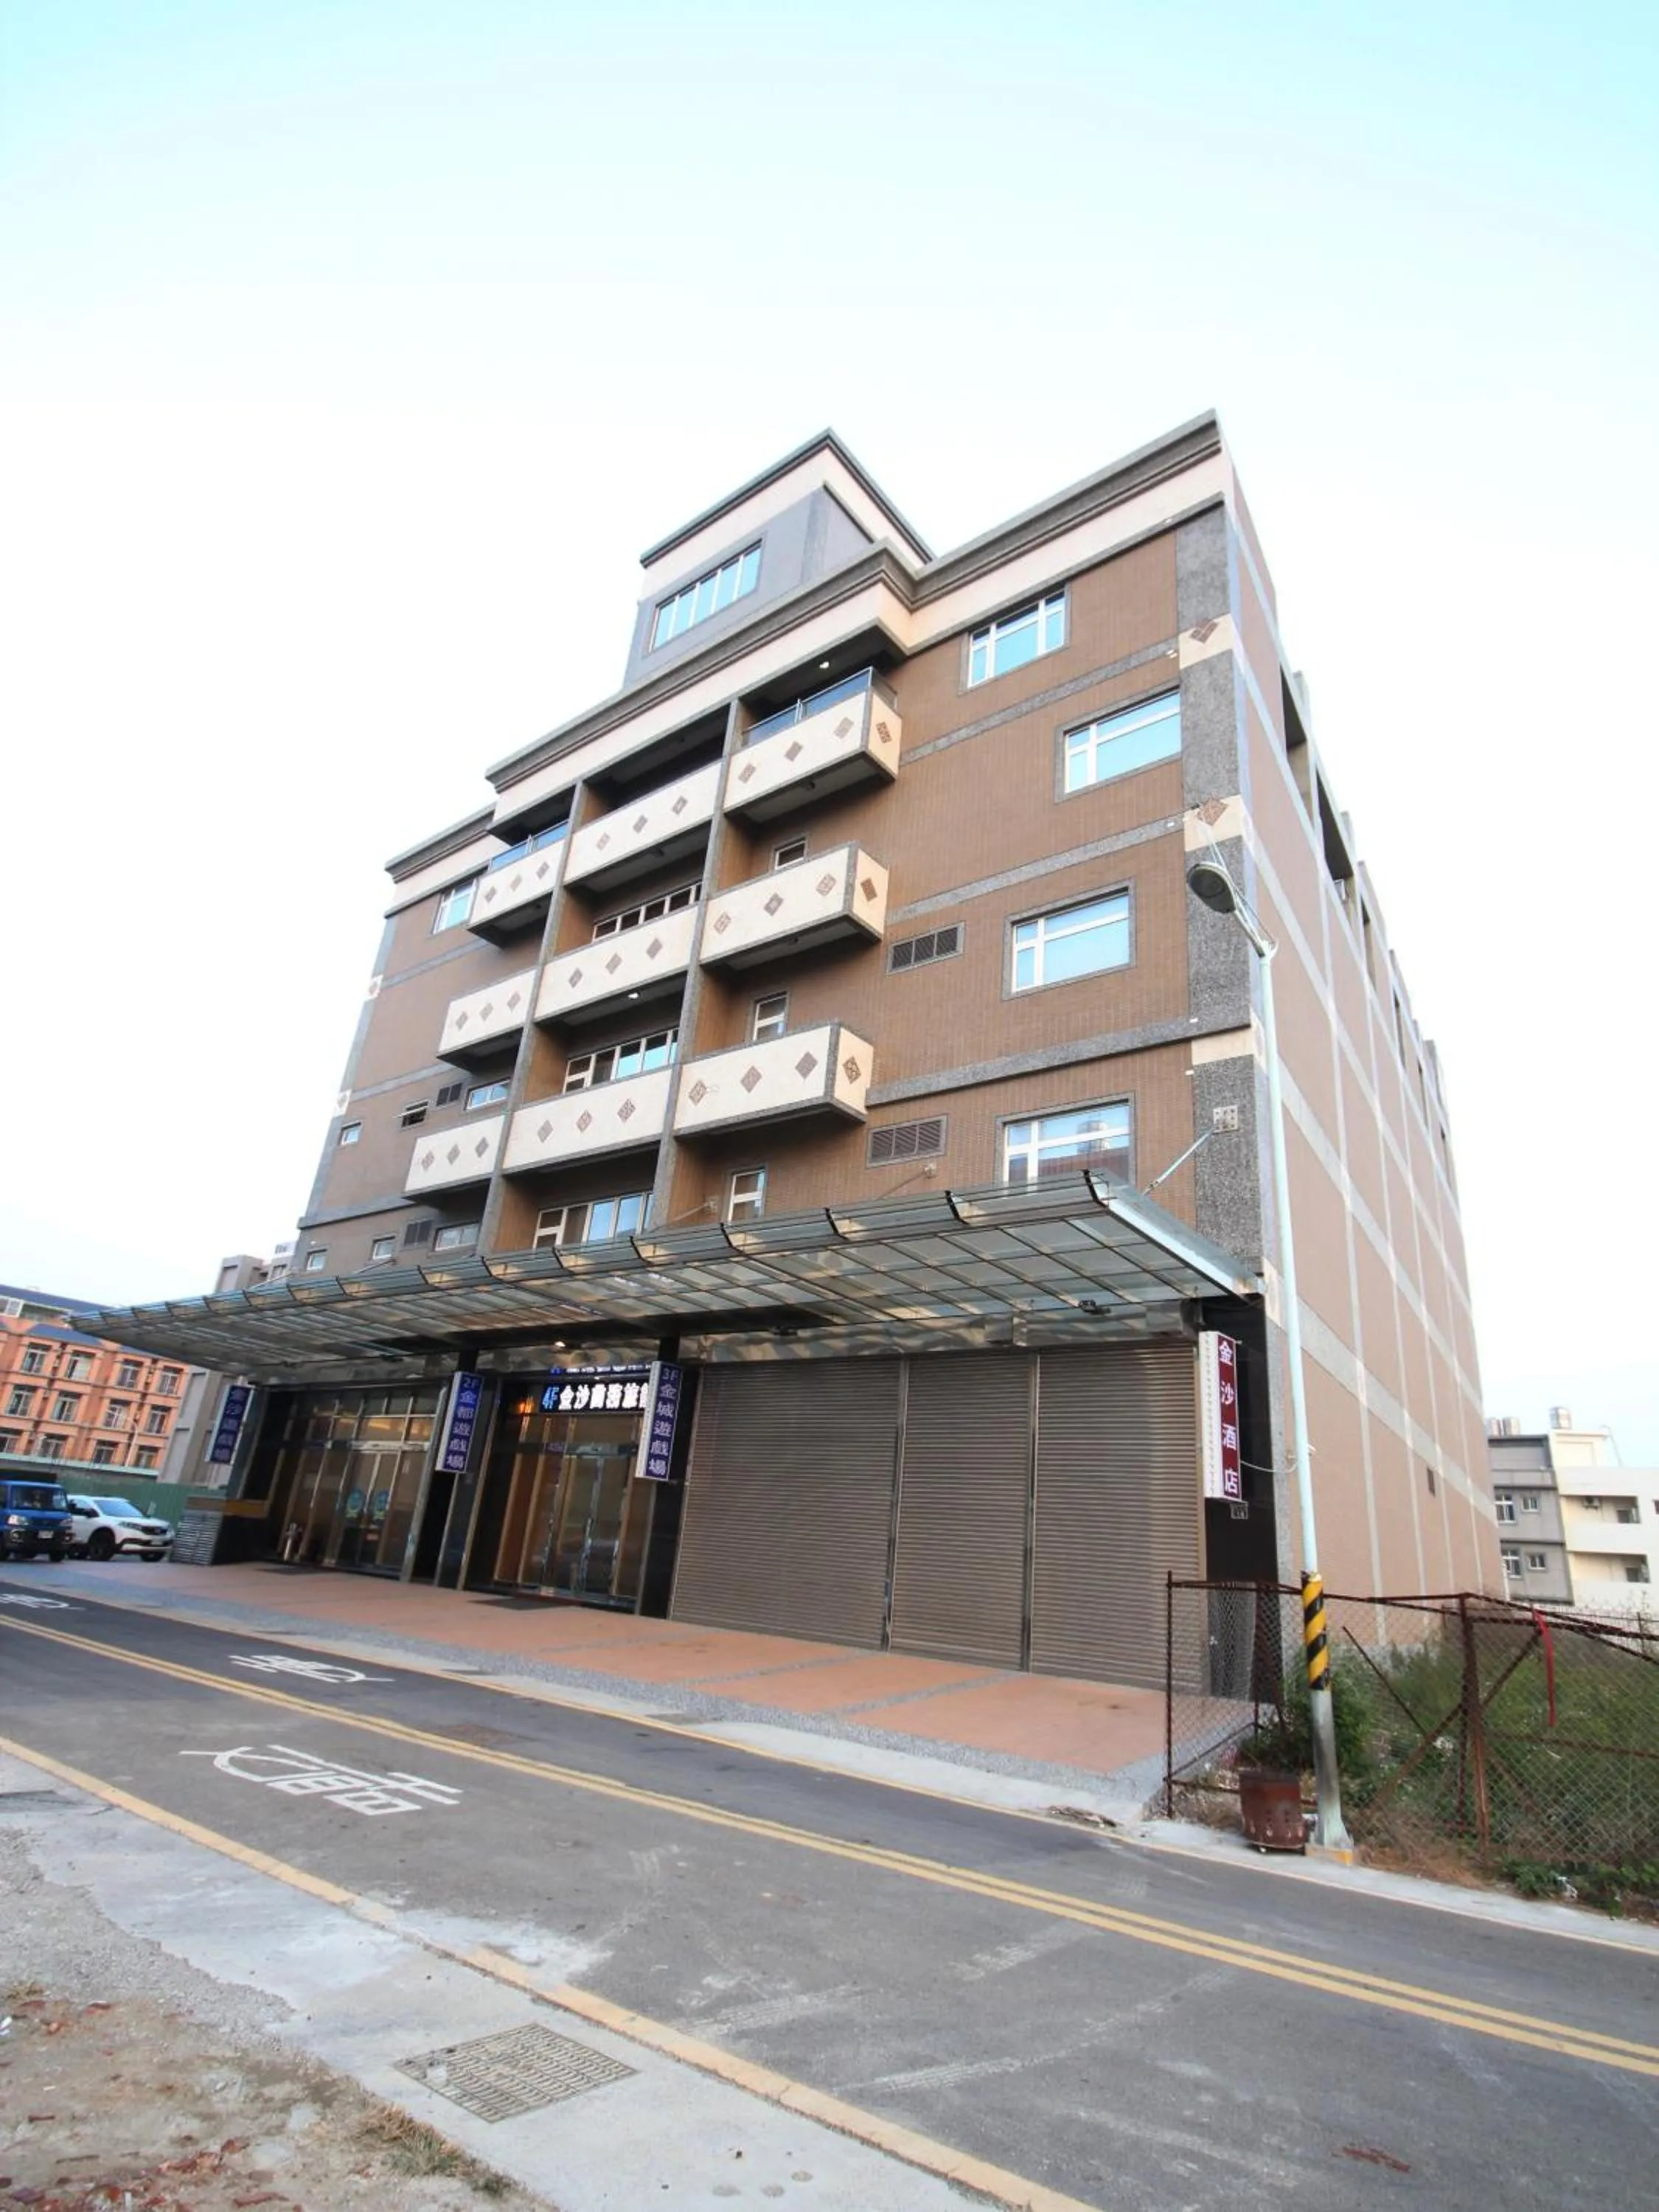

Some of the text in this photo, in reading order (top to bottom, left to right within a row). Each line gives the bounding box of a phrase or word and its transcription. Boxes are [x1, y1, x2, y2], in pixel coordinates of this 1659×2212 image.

[662, 1368, 679, 1381] 3F
[1219, 1340, 1239, 1495] 金沙酒店
[178, 1744, 464, 1816] 慢
